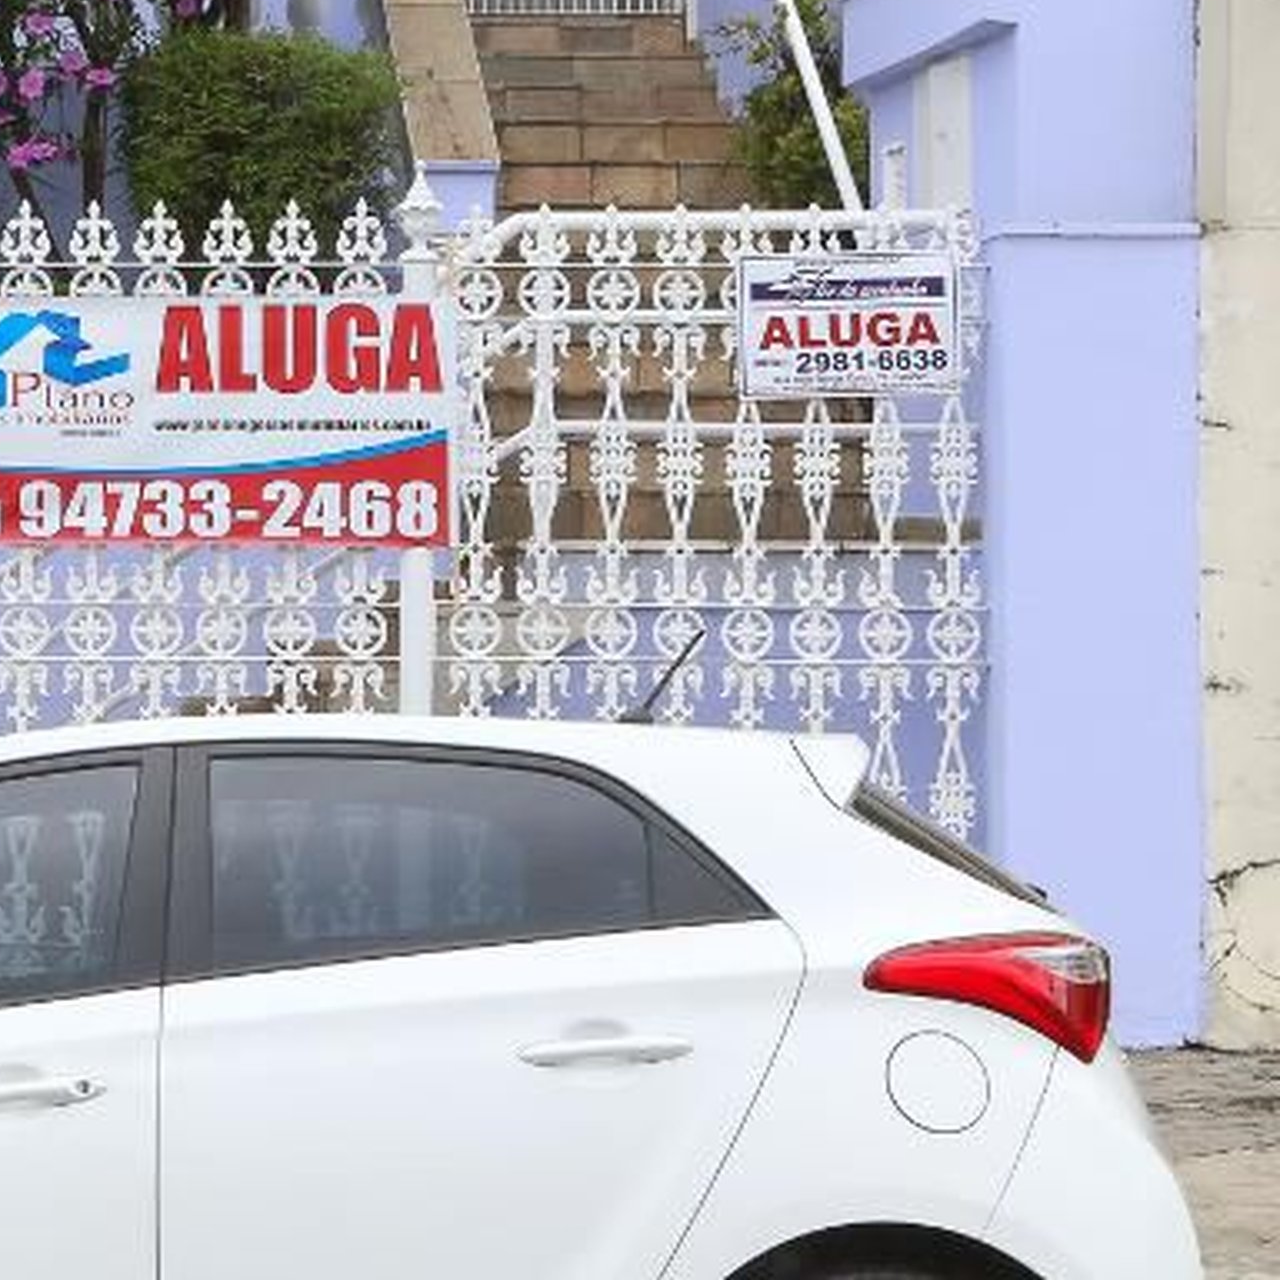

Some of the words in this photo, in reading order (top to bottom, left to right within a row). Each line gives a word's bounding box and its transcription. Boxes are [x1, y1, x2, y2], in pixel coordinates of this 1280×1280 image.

[155, 303, 445, 394] ALUGA
[760, 312, 941, 351] ALUGA
[796, 349, 948, 374] 2981-6638
[11, 372, 134, 409] Plano
[20, 479, 439, 540] 94733-2468
